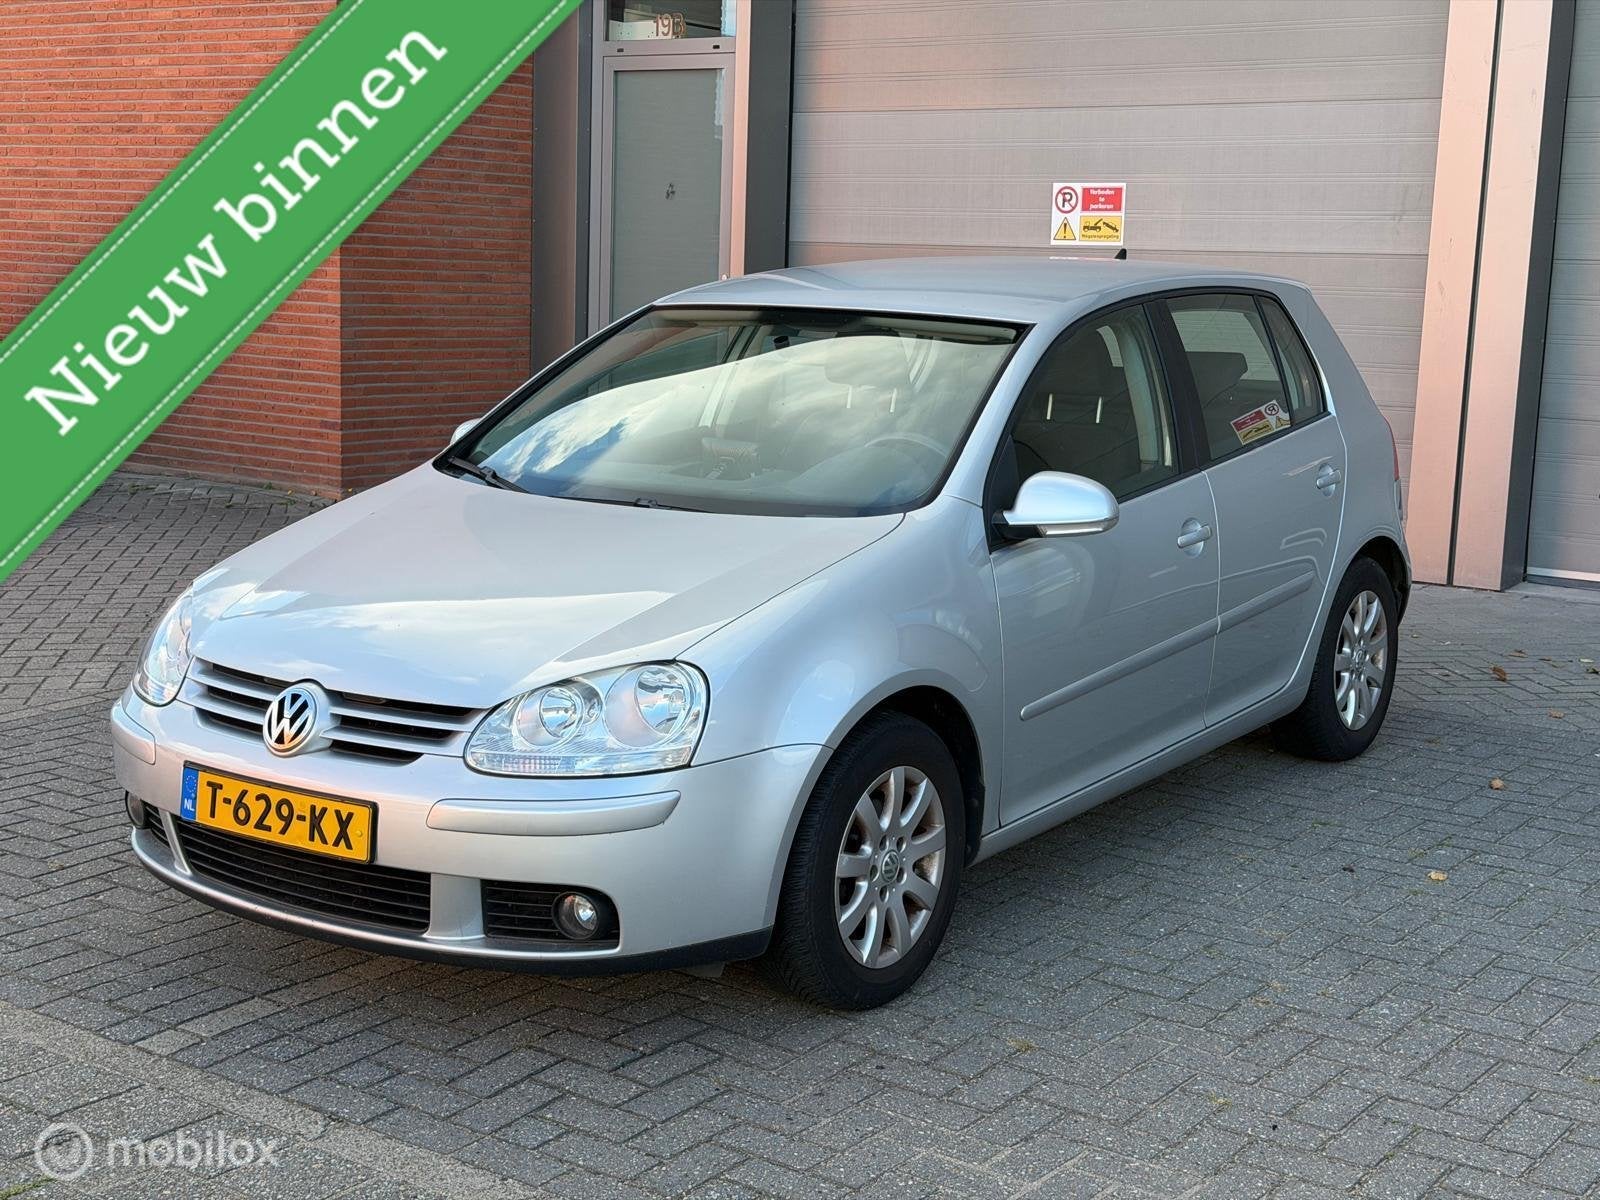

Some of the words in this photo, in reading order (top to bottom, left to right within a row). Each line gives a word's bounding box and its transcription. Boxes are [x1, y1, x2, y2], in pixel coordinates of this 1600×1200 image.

[653, 12, 686, 37] 19B
[264, 688, 317, 750] VW
[183, 798, 196, 812] NL
[206, 780, 354, 851] T-629-KX
